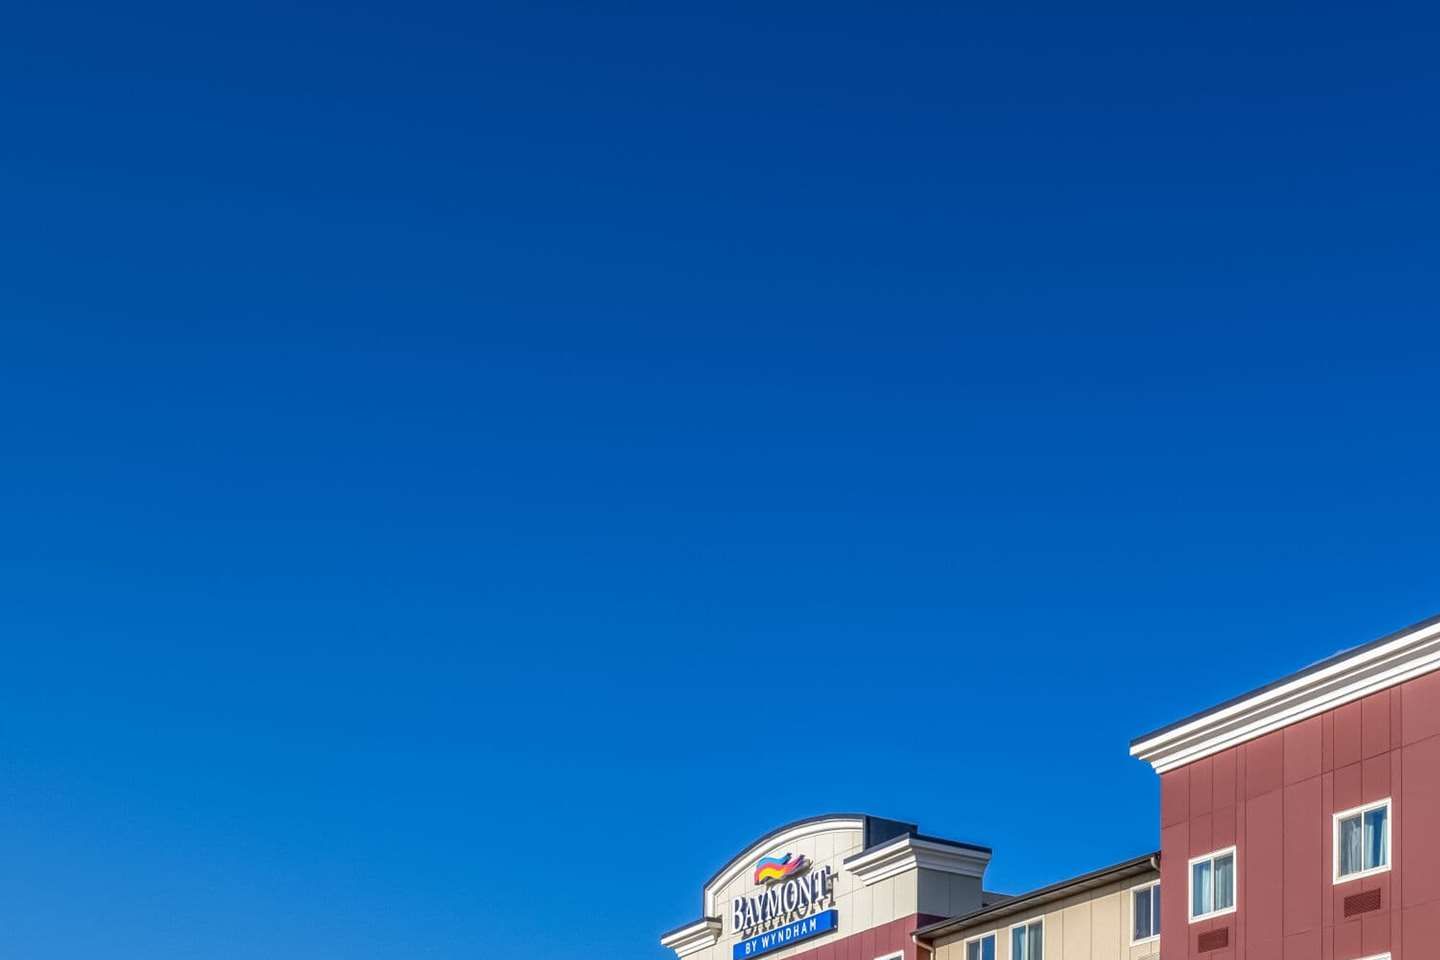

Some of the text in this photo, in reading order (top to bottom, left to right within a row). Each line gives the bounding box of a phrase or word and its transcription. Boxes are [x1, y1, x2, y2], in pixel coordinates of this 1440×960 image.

[731, 866, 830, 935] BAYMONT
[745, 918, 817, 955] BY WYNDHAM
